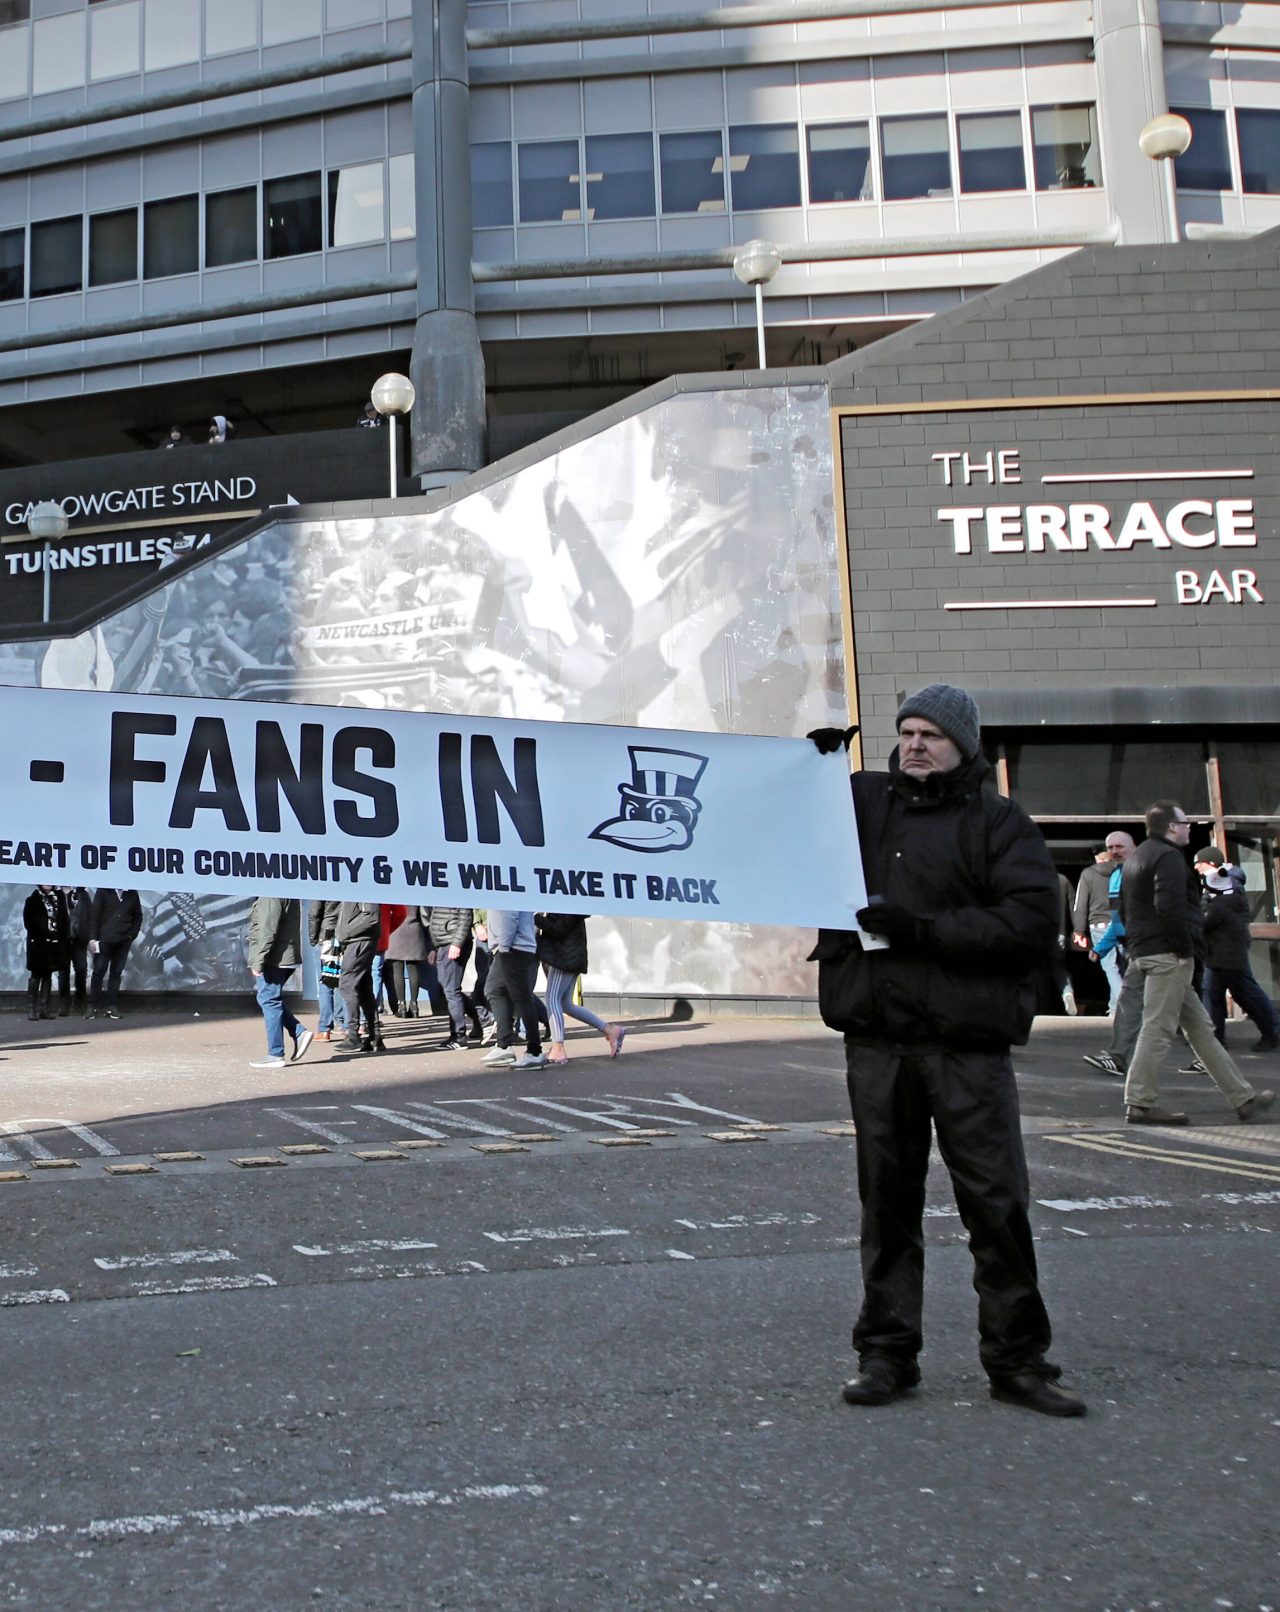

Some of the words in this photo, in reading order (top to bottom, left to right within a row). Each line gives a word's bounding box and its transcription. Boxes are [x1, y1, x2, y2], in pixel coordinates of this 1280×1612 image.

[931, 449, 1021, 486] THE
[5, 485, 165, 525] GAOWGATE
[172, 476, 256, 504] STAND
[937, 499, 1257, 554] TERRACE
[5, 537, 172, 575] TURNSTILES
[1175, 568, 1264, 604] BAR
[318, 617, 422, 640] NEWCASTLE
[29, 759, 65, 784] -
[108, 710, 400, 839] FANS
[438, 731, 546, 848] IN
[80, 844, 118, 871] OF
[127, 846, 184, 875] OUR
[193, 849, 364, 883] COMMUNITY
[372, 855, 393, 885] &
[402, 859, 449, 888] WE
[457, 862, 526, 893] WILL
[533, 867, 605, 898] TAKE
[612, 872, 638, 900] IT
[645, 875, 720, 905] BACK
